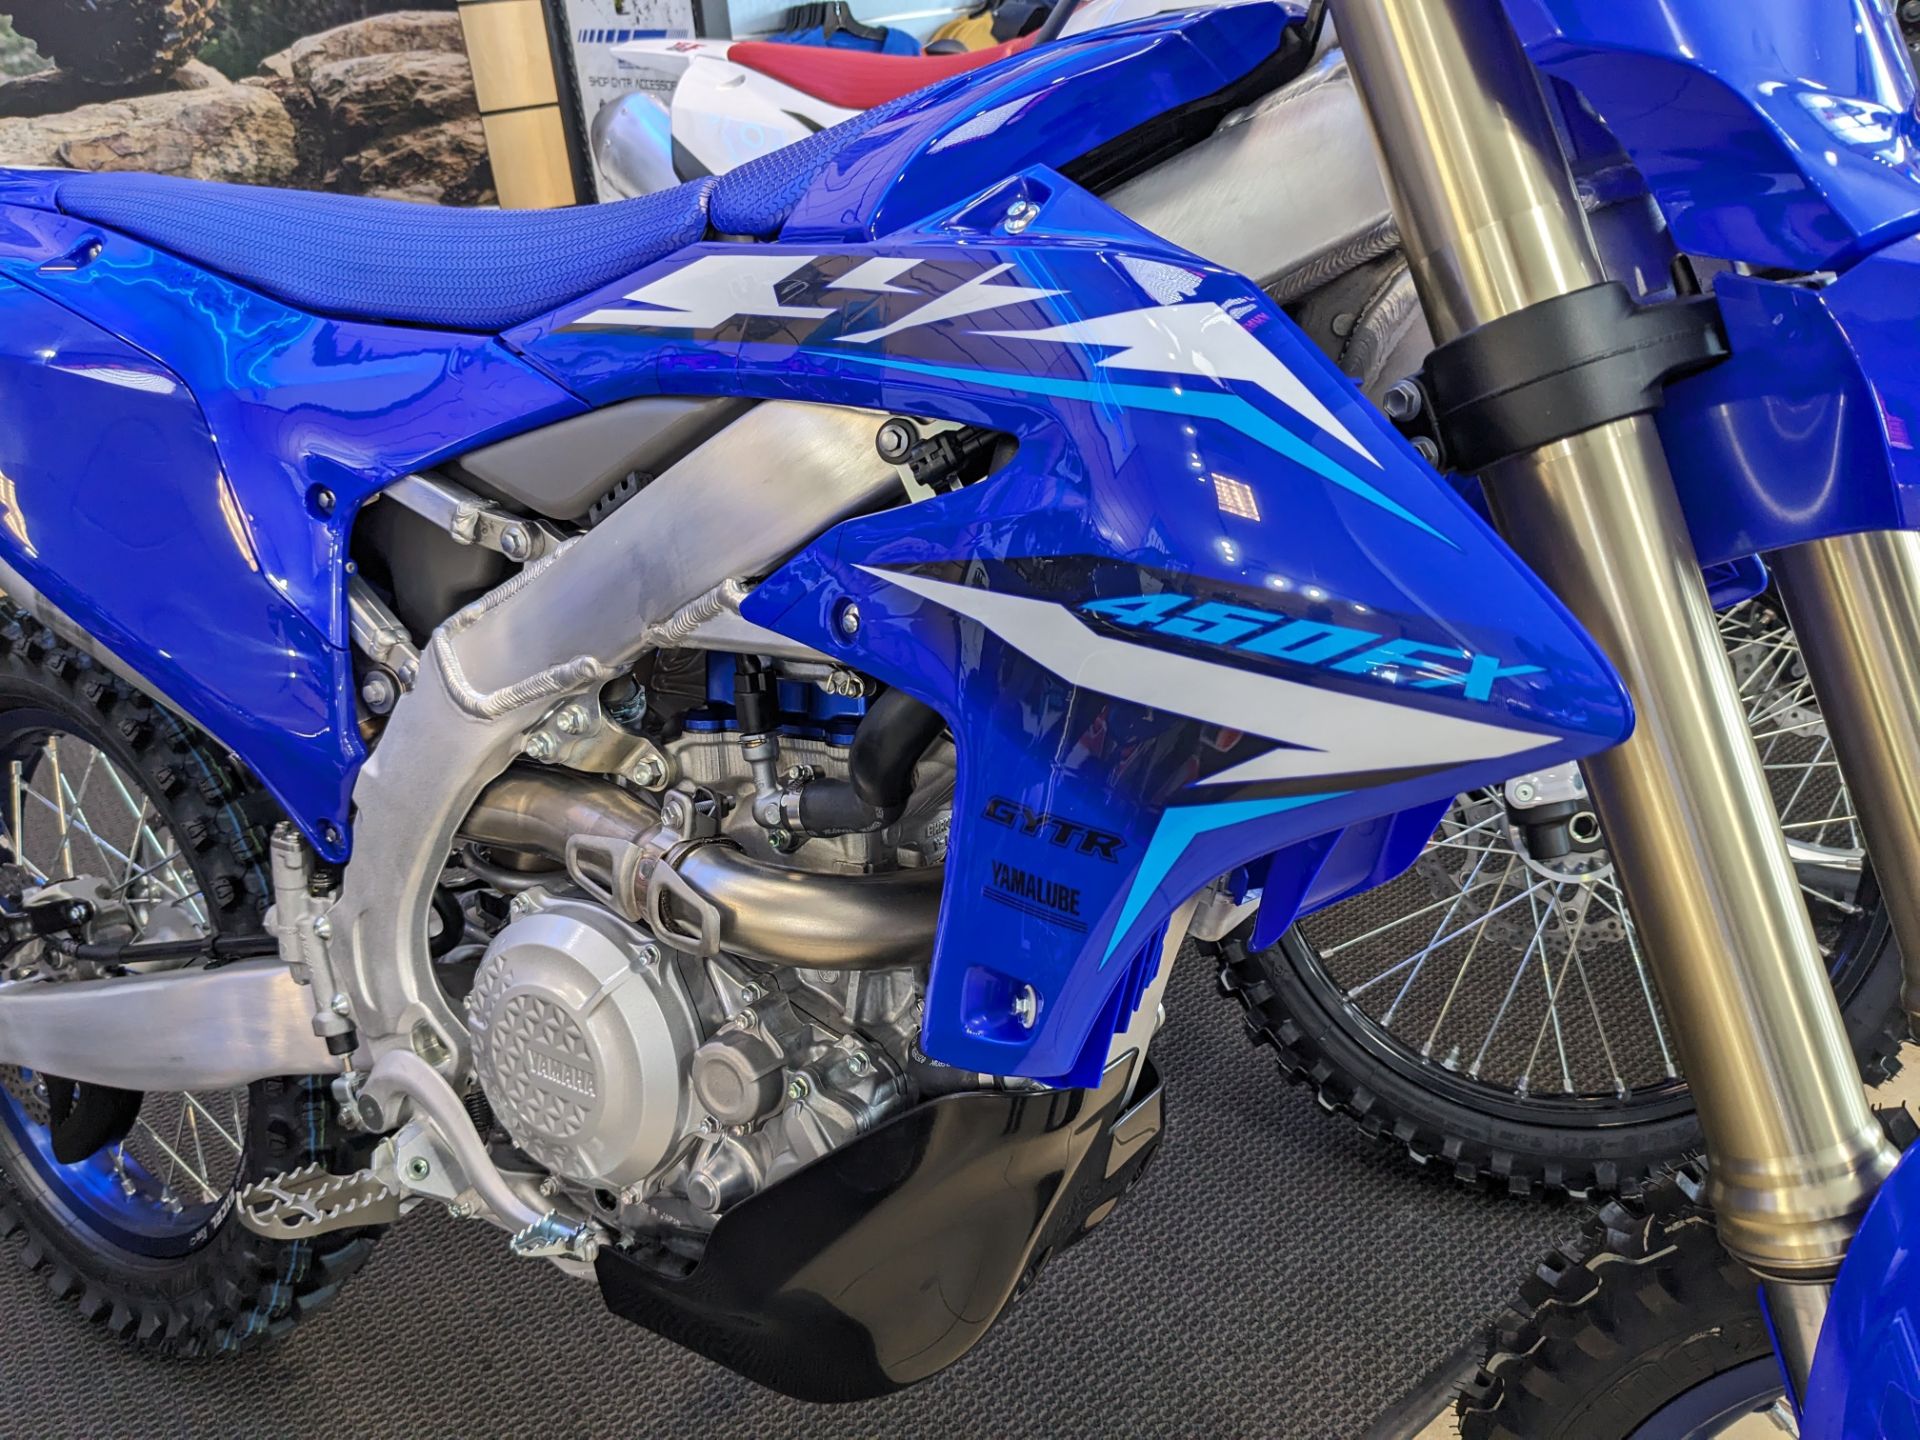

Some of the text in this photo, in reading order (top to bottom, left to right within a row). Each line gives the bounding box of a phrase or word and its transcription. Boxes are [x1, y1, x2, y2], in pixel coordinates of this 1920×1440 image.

[1079, 593, 1548, 701] 450FX
[980, 795, 1127, 863] GYTR
[991, 859, 1081, 916] YAMALUBE
[527, 1049, 596, 1098] YAMAHA
